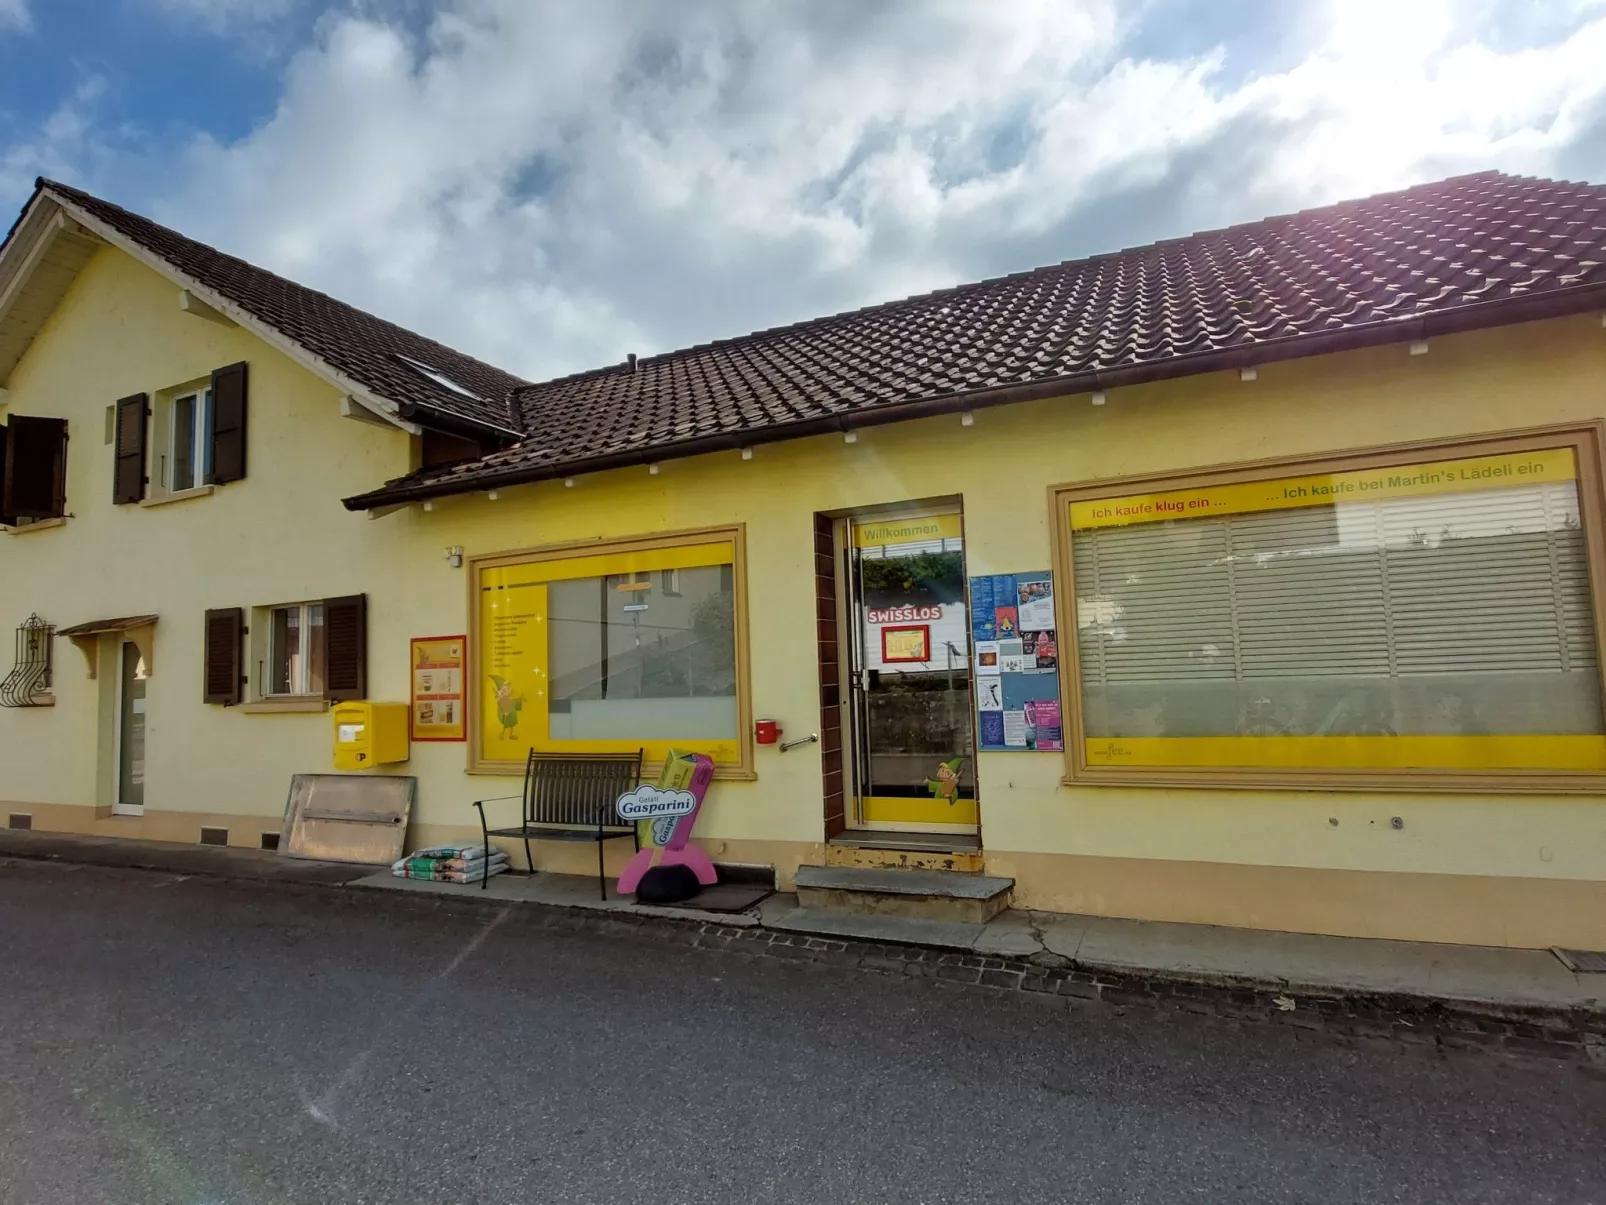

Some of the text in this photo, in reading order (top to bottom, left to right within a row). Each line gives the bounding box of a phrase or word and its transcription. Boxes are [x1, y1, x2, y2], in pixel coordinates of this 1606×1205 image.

[1283, 486, 1307, 499] Ich
[1311, 481, 1355, 496] kaufe
[1359, 478, 1384, 491] bei
[1460, 463, 1512, 480] Lädeli
[1517, 462, 1544, 475] ein
[1092, 508, 1112, 519] Ich
[1115, 504, 1152, 516] kaufe
[1155, 500, 1185, 512] klug
[1188, 498, 1210, 508] ein
[863, 524, 938, 540] Willkommen
[868, 607, 941, 623] SWISSLOS
[622, 798, 690, 814] Gasparini
[638, 796, 659, 804] Gelati
[659, 815, 676, 843] Gaspa
